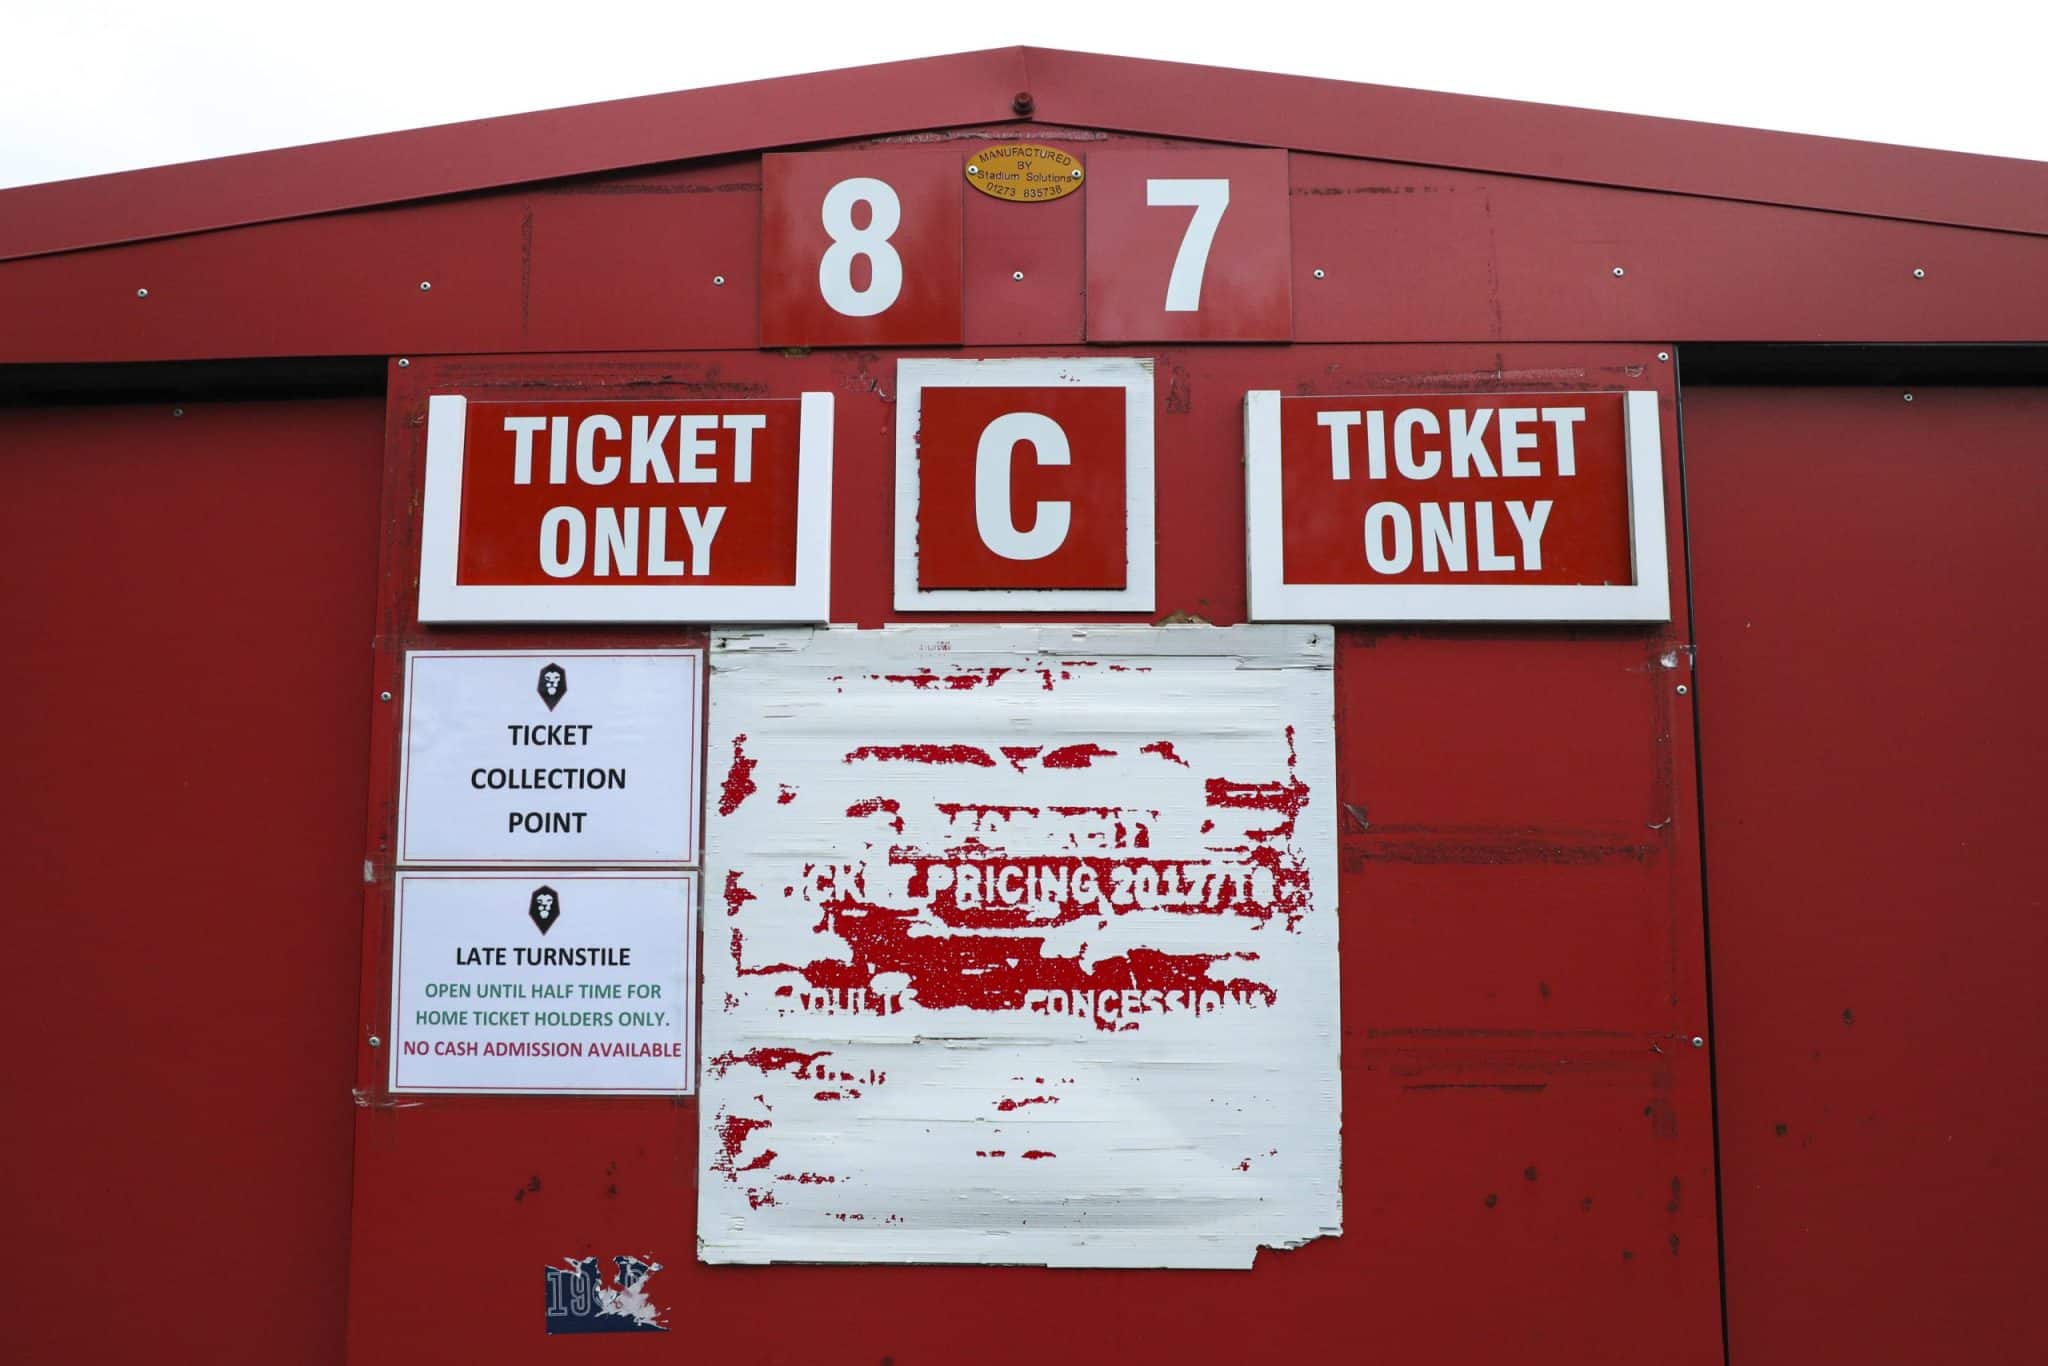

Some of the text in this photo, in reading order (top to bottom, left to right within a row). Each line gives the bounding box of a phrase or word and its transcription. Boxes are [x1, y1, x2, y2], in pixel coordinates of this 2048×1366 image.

[978, 147, 1072, 166] MANUFACTURED
[1017, 160, 1033, 170] BY
[978, 169, 1073, 183] Stadium Solutions
[986, 182, 1016, 197] 01273
[819, 177, 902, 317] 8
[1146, 179, 1230, 312] 7
[504, 414, 766, 486] TICKET
[1317, 406, 1585, 481] TICKET
[976, 412, 1071, 560] C
[540, 506, 726, 578] ONLY
[1365, 500, 1553, 575] ONLY
[508, 725, 592, 747] TICKET
[471, 767, 626, 790] COLLECTION
[509, 812, 587, 833] POINT
[927, 863, 1099, 905] PRICING
[457, 947, 631, 967] LATE TURNSTILE
[425, 983, 662, 999] OPEN UNTIL HALF TIME FOR
[416, 1010, 670, 1027] HOME TICKET HOLDERS ONLY.
[404, 1040, 682, 1058] NO CASH ADMISSION AVAILABLE
